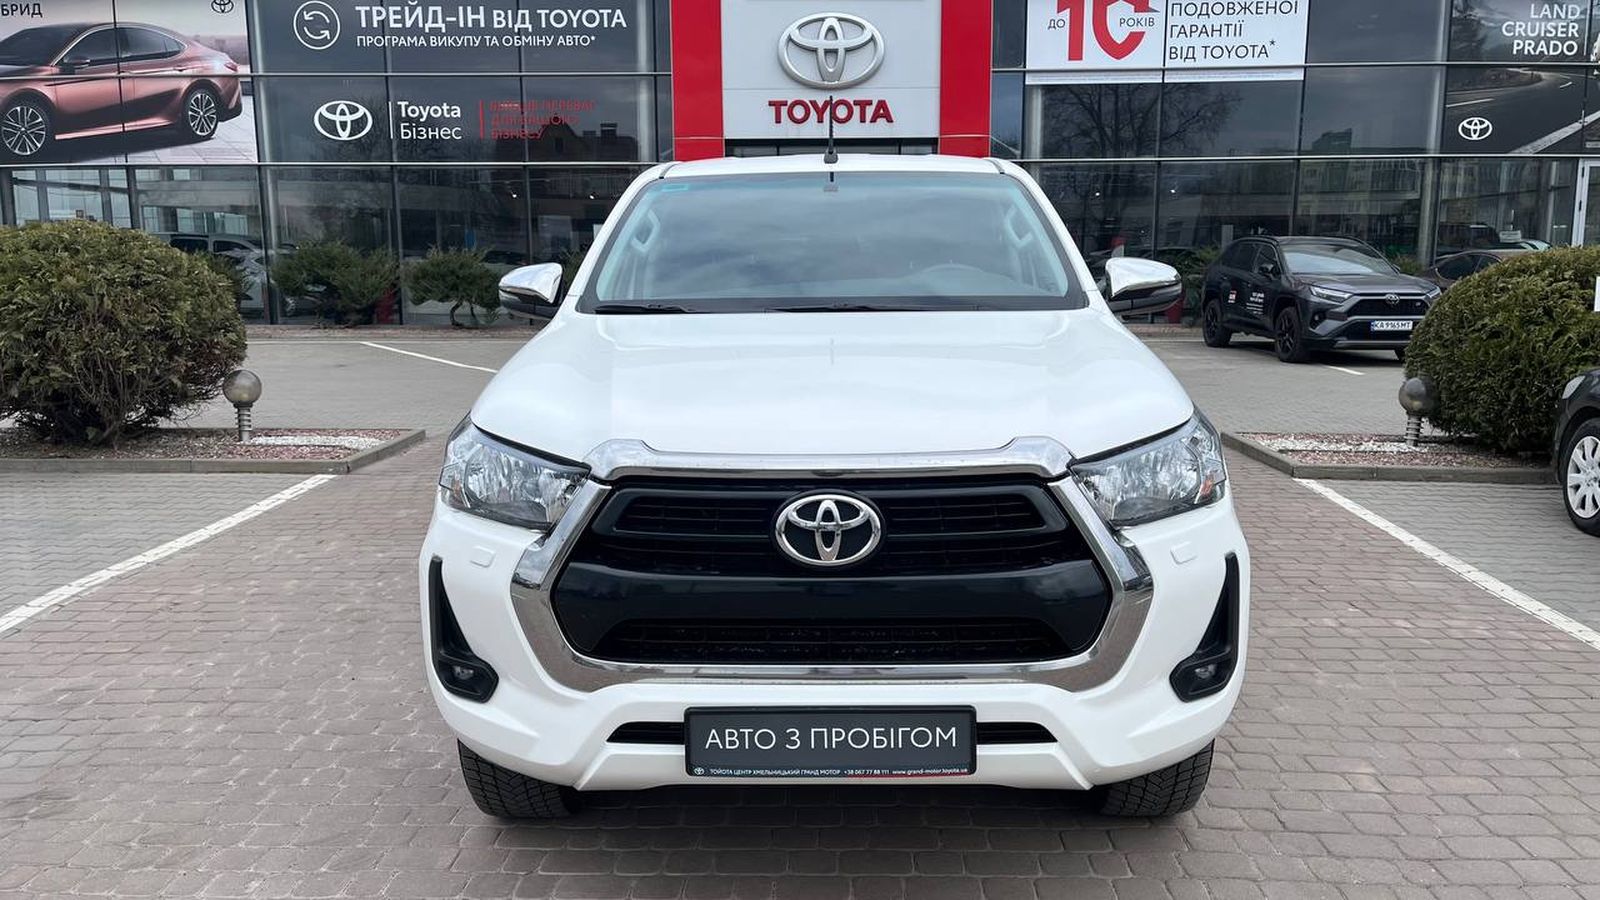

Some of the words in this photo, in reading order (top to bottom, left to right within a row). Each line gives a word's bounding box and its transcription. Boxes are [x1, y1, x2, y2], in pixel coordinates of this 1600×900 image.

[355, 1, 485, 33] ТРЕЙД-ІН
[493, 9, 532, 33] ВІД
[536, 9, 627, 28] TOYOTA
[1530, 3, 1580, 19] LAND
[1047, 18, 1066, 30] ДО
[1119, 17, 1156, 28] РОКІВ
[1170, 20, 1245, 38] ГАРАНТІЇ
[1502, 21, 1579, 37] CRUISER
[356, 35, 427, 47] ПРОГРАМА
[429, 35, 481, 47] ВИКУПУ
[484, 35, 500, 47] ТА
[502, 35, 554, 47] ОБМІНУ
[1513, 39, 1579, 56] PRADO
[1169, 45, 1197, 62] ВІД
[397, 101, 461, 122] Toyota
[768, 99, 894, 124] TOYOTA
[400, 123, 462, 140] Бізнес
[705, 728, 776, 750] АВТО
[785, 727, 801, 750] З
[810, 726, 956, 750] ПРОБІГОМ
